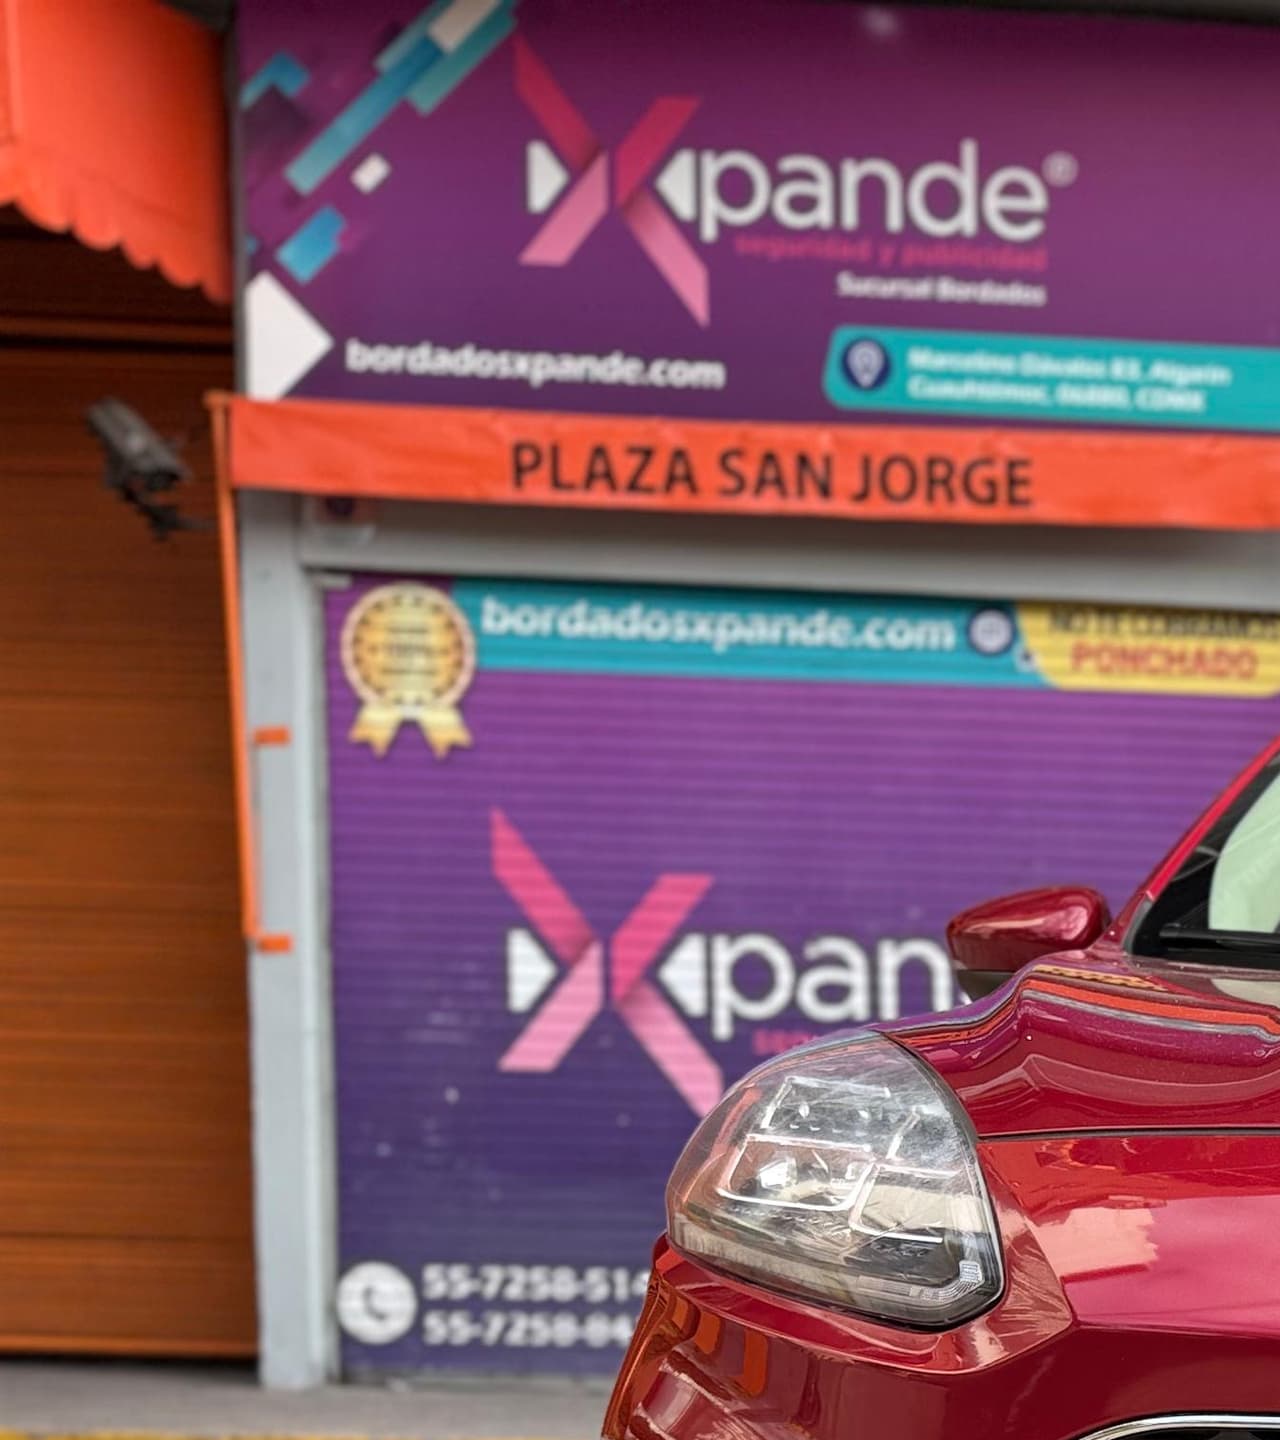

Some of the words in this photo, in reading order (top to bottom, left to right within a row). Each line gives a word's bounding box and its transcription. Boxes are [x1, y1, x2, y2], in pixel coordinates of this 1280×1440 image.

[345, 335, 725, 390] bordadosxpande.com
[510, 442, 700, 497] PLAZA
[718, 448, 833, 500] SAN
[851, 454, 1034, 508] JORGE
[480, 595, 956, 654] bordadosxpande.com
[490, 804, 974, 1117] Xpan
